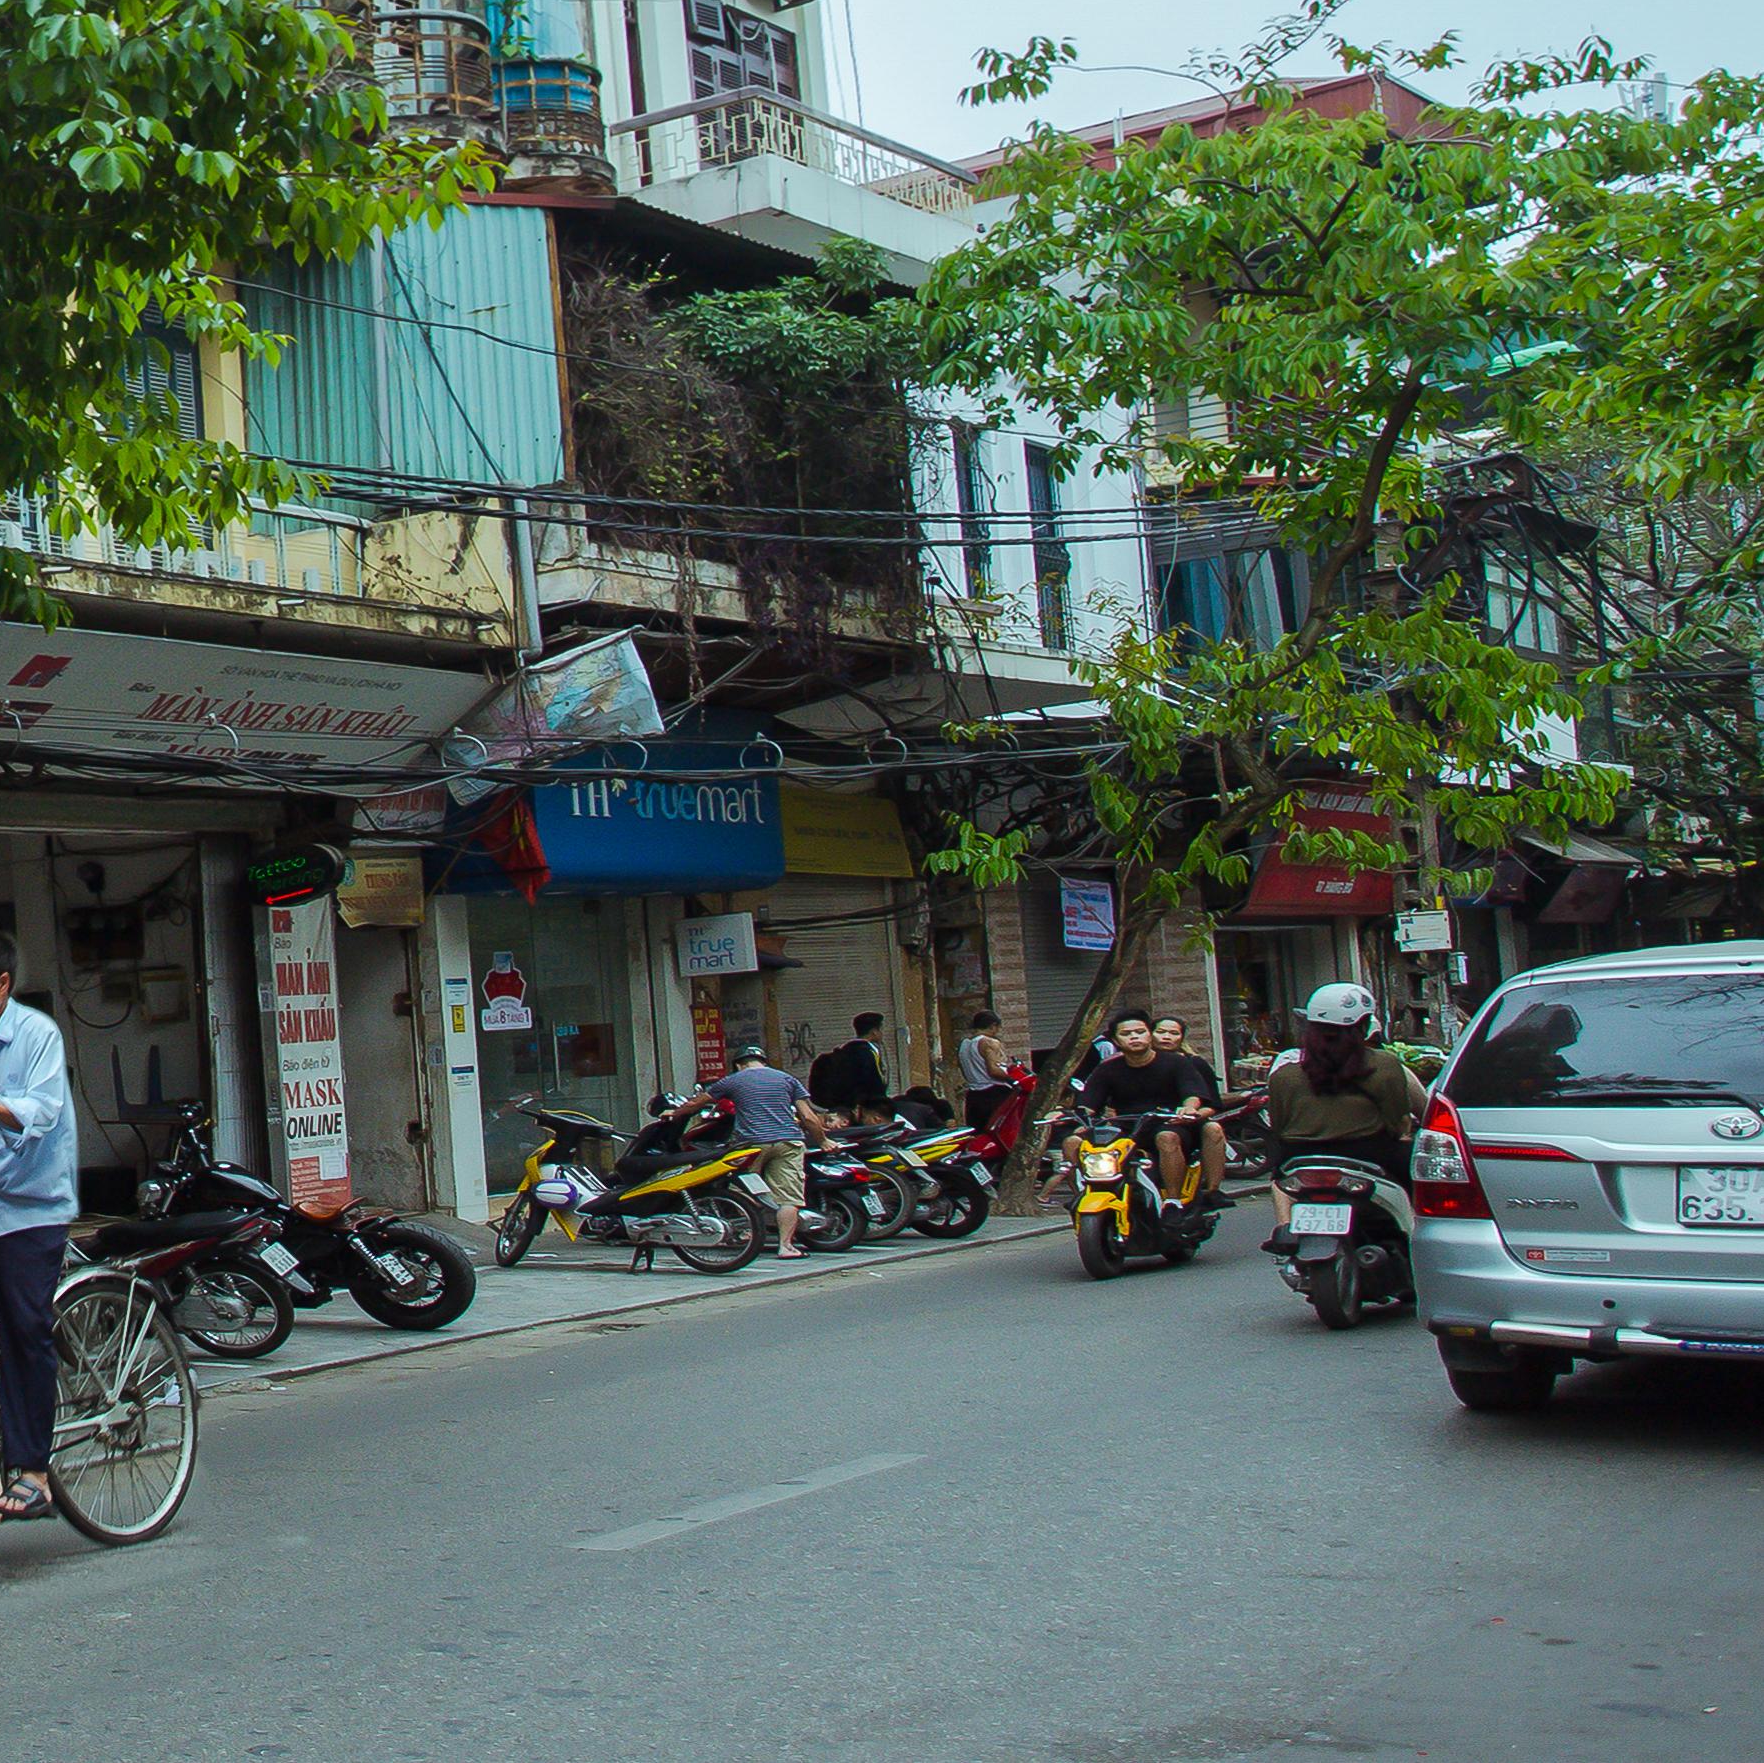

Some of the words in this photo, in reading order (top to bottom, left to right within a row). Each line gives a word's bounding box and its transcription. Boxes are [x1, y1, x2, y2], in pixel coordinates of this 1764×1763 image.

[136, 686, 223, 724] MÀN
[216, 690, 286, 730] ẢNH
[688, 936, 735, 955] true
[689, 952, 736, 969] mart
[282, 1077, 342, 1110] MASK
[286, 1112, 343, 1140] ONLINE
